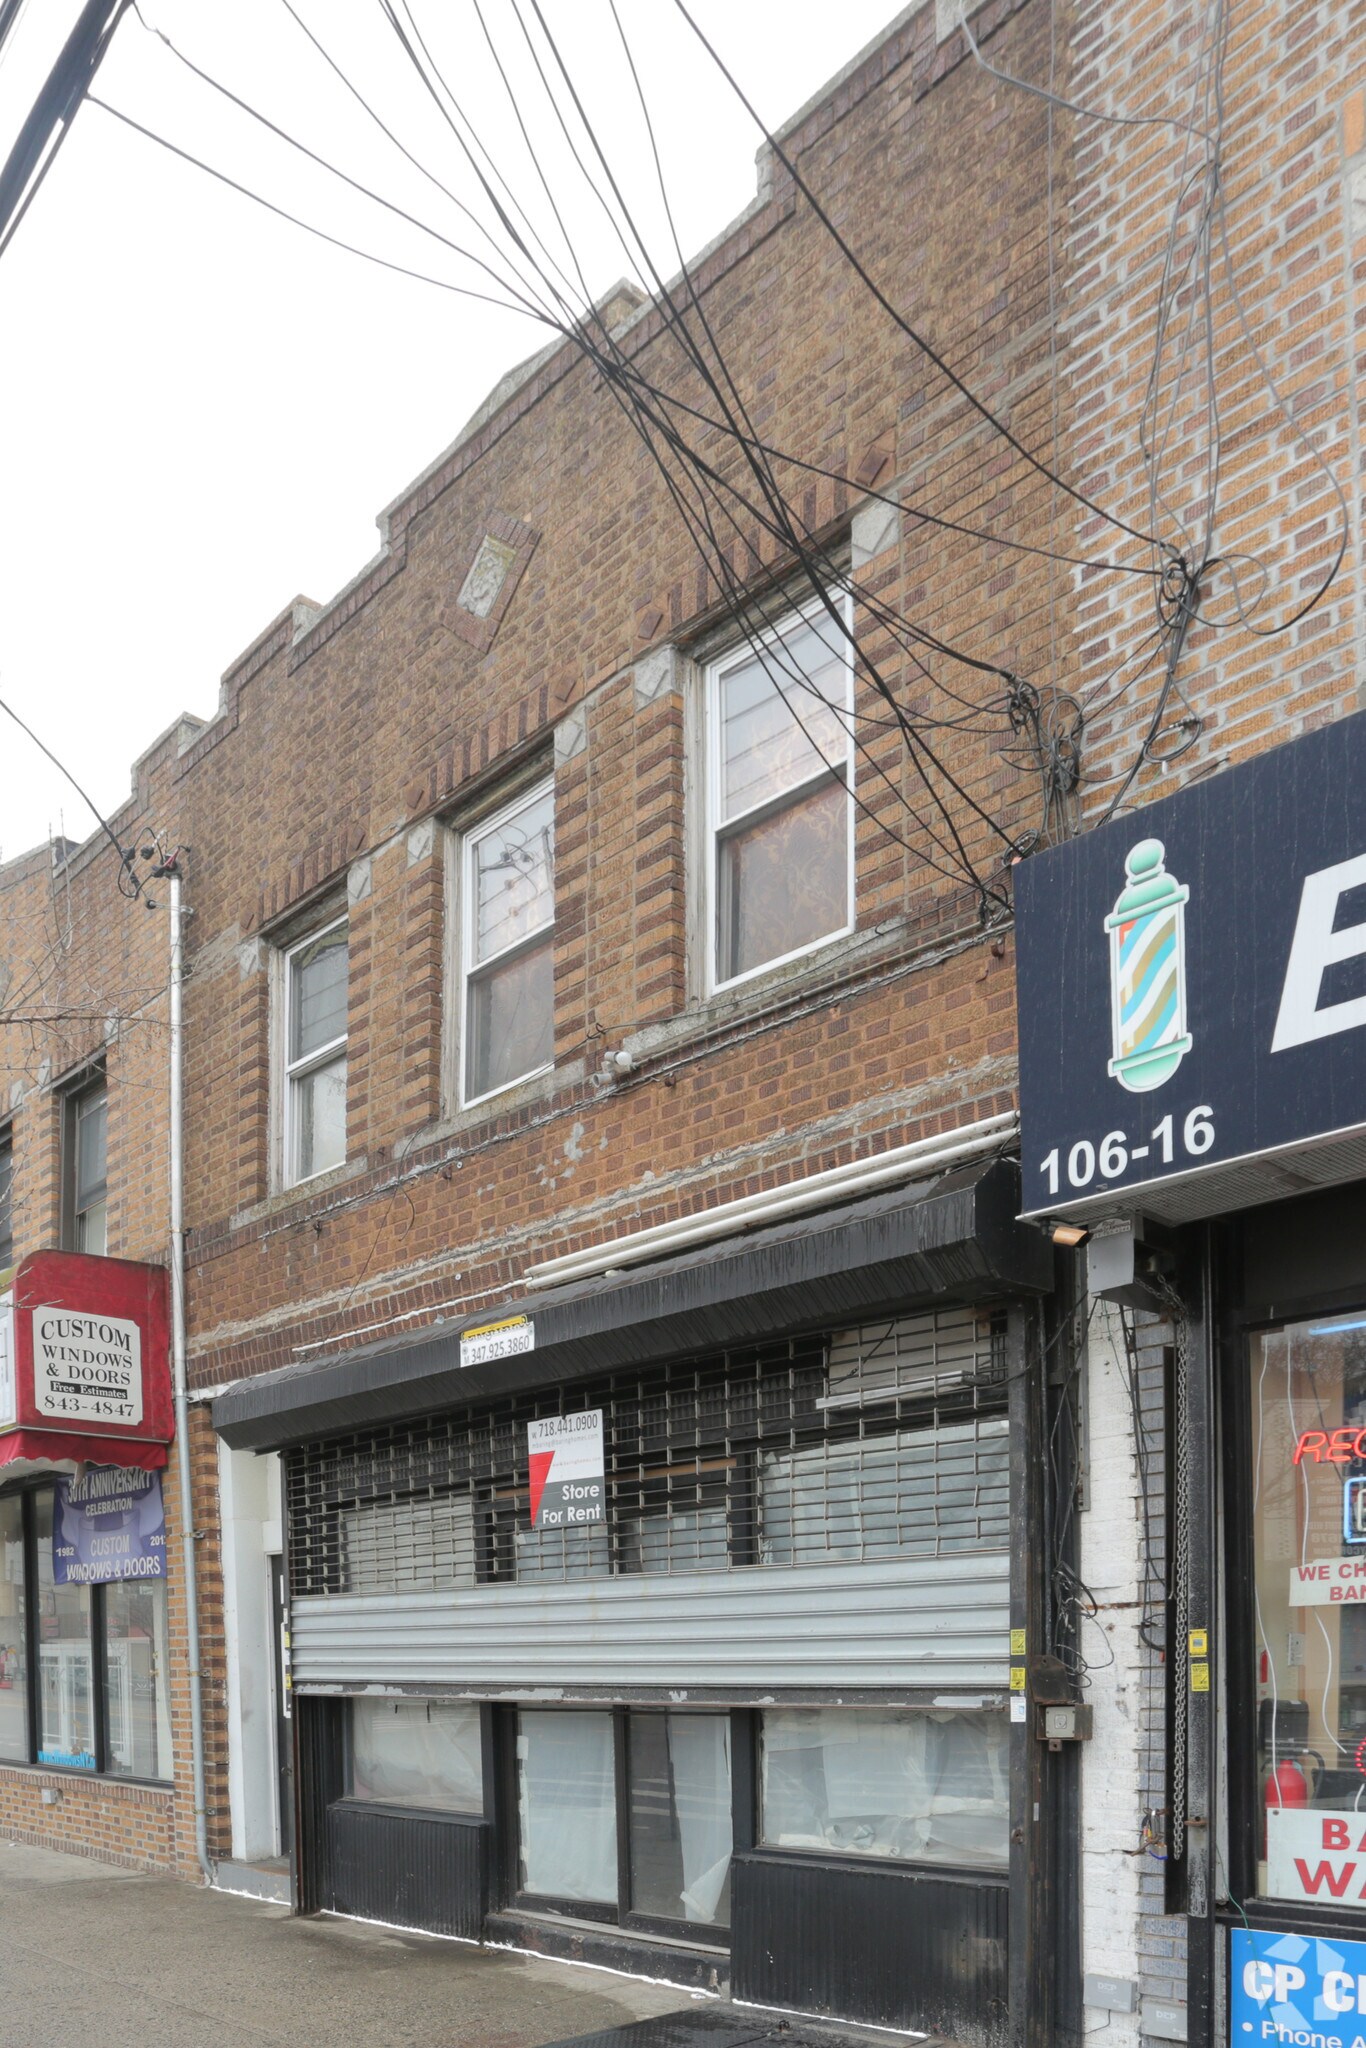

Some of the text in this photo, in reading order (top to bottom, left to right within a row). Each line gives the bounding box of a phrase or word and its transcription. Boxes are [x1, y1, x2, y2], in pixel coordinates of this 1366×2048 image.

[1039, 1105, 1216, 1195] 106-16
[41, 1319, 132, 1353] CUSTOM
[42, 1344, 133, 1369] WINDOWS
[471, 1335, 530, 1363] 347.925.3860
[46, 1362, 131, 1386] & DOORS
[52, 1382, 127, 1399] Free Estimates
[44, 1395, 135, 1417] 843-4847
[538, 1413, 598, 1437] 718.441.0900
[561, 1484, 600, 1501] Store
[85, 1497, 133, 1517] CELEBRATION
[542, 1503, 601, 1525] For Rent
[56, 1547, 75, 1558] 1982
[90, 1534, 130, 1557] CUSTOM
[150, 1534, 166, 1547] 201
[66, 1555, 161, 1582] WINDOWS & DOORS
[1297, 1565, 1331, 1582] WE
[1322, 1818, 1366, 1852] B
[1293, 1858, 1366, 1899] W
[1243, 1960, 1306, 2003] CP
[1261, 2020, 1343, 2048] Phone
